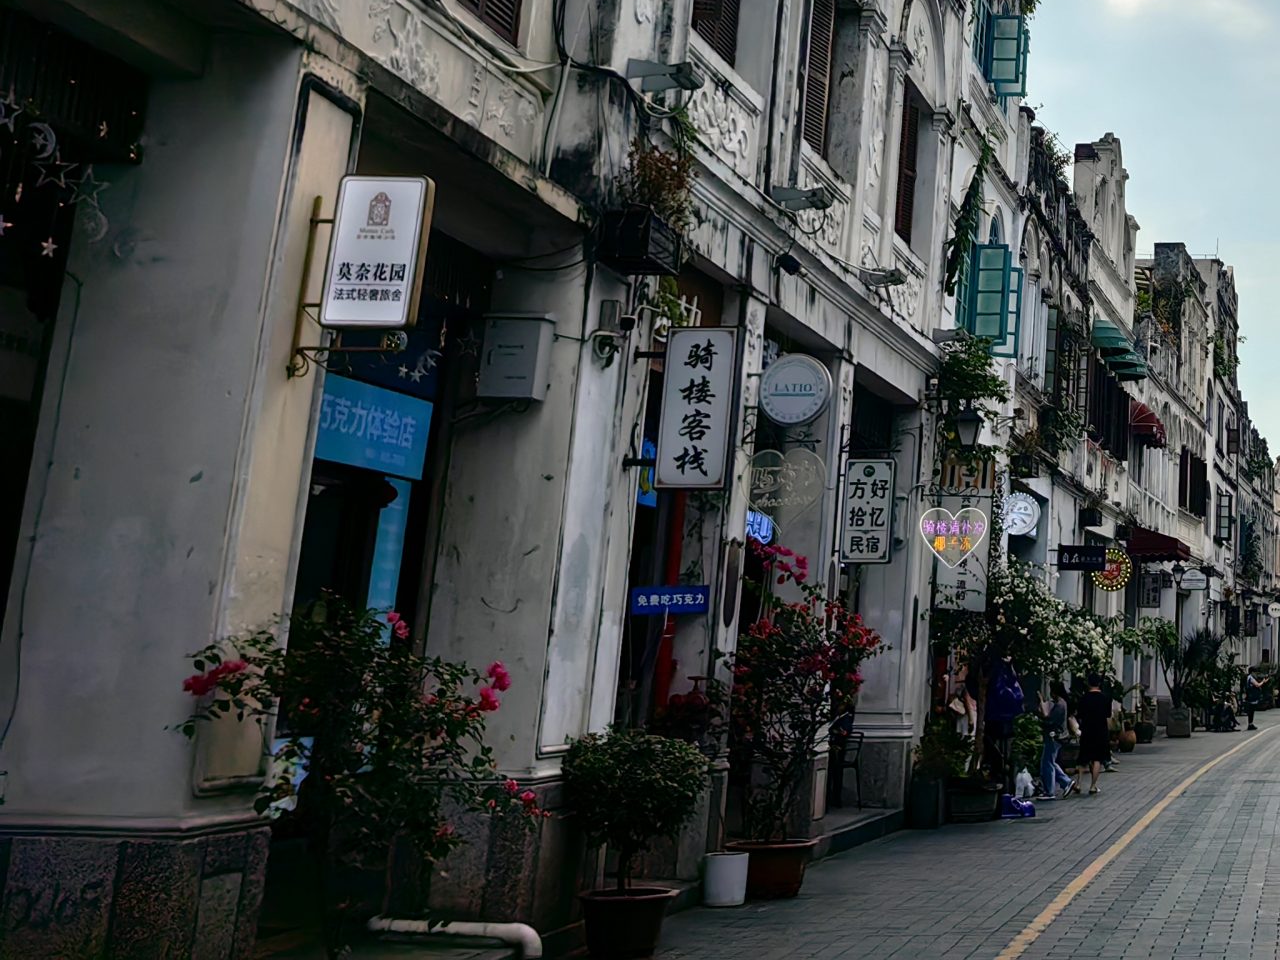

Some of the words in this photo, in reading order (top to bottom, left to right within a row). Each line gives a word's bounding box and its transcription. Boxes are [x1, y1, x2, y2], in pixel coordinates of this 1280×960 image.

[336, 261, 406, 282] 莫奈花园
[333, 287, 402, 302] 法式轻奢旅舍
[673, 338, 718, 477] 骑楼客栈
[849, 535, 880, 554] 民宿
[637, 593, 705, 607] 免费吃巧克力
